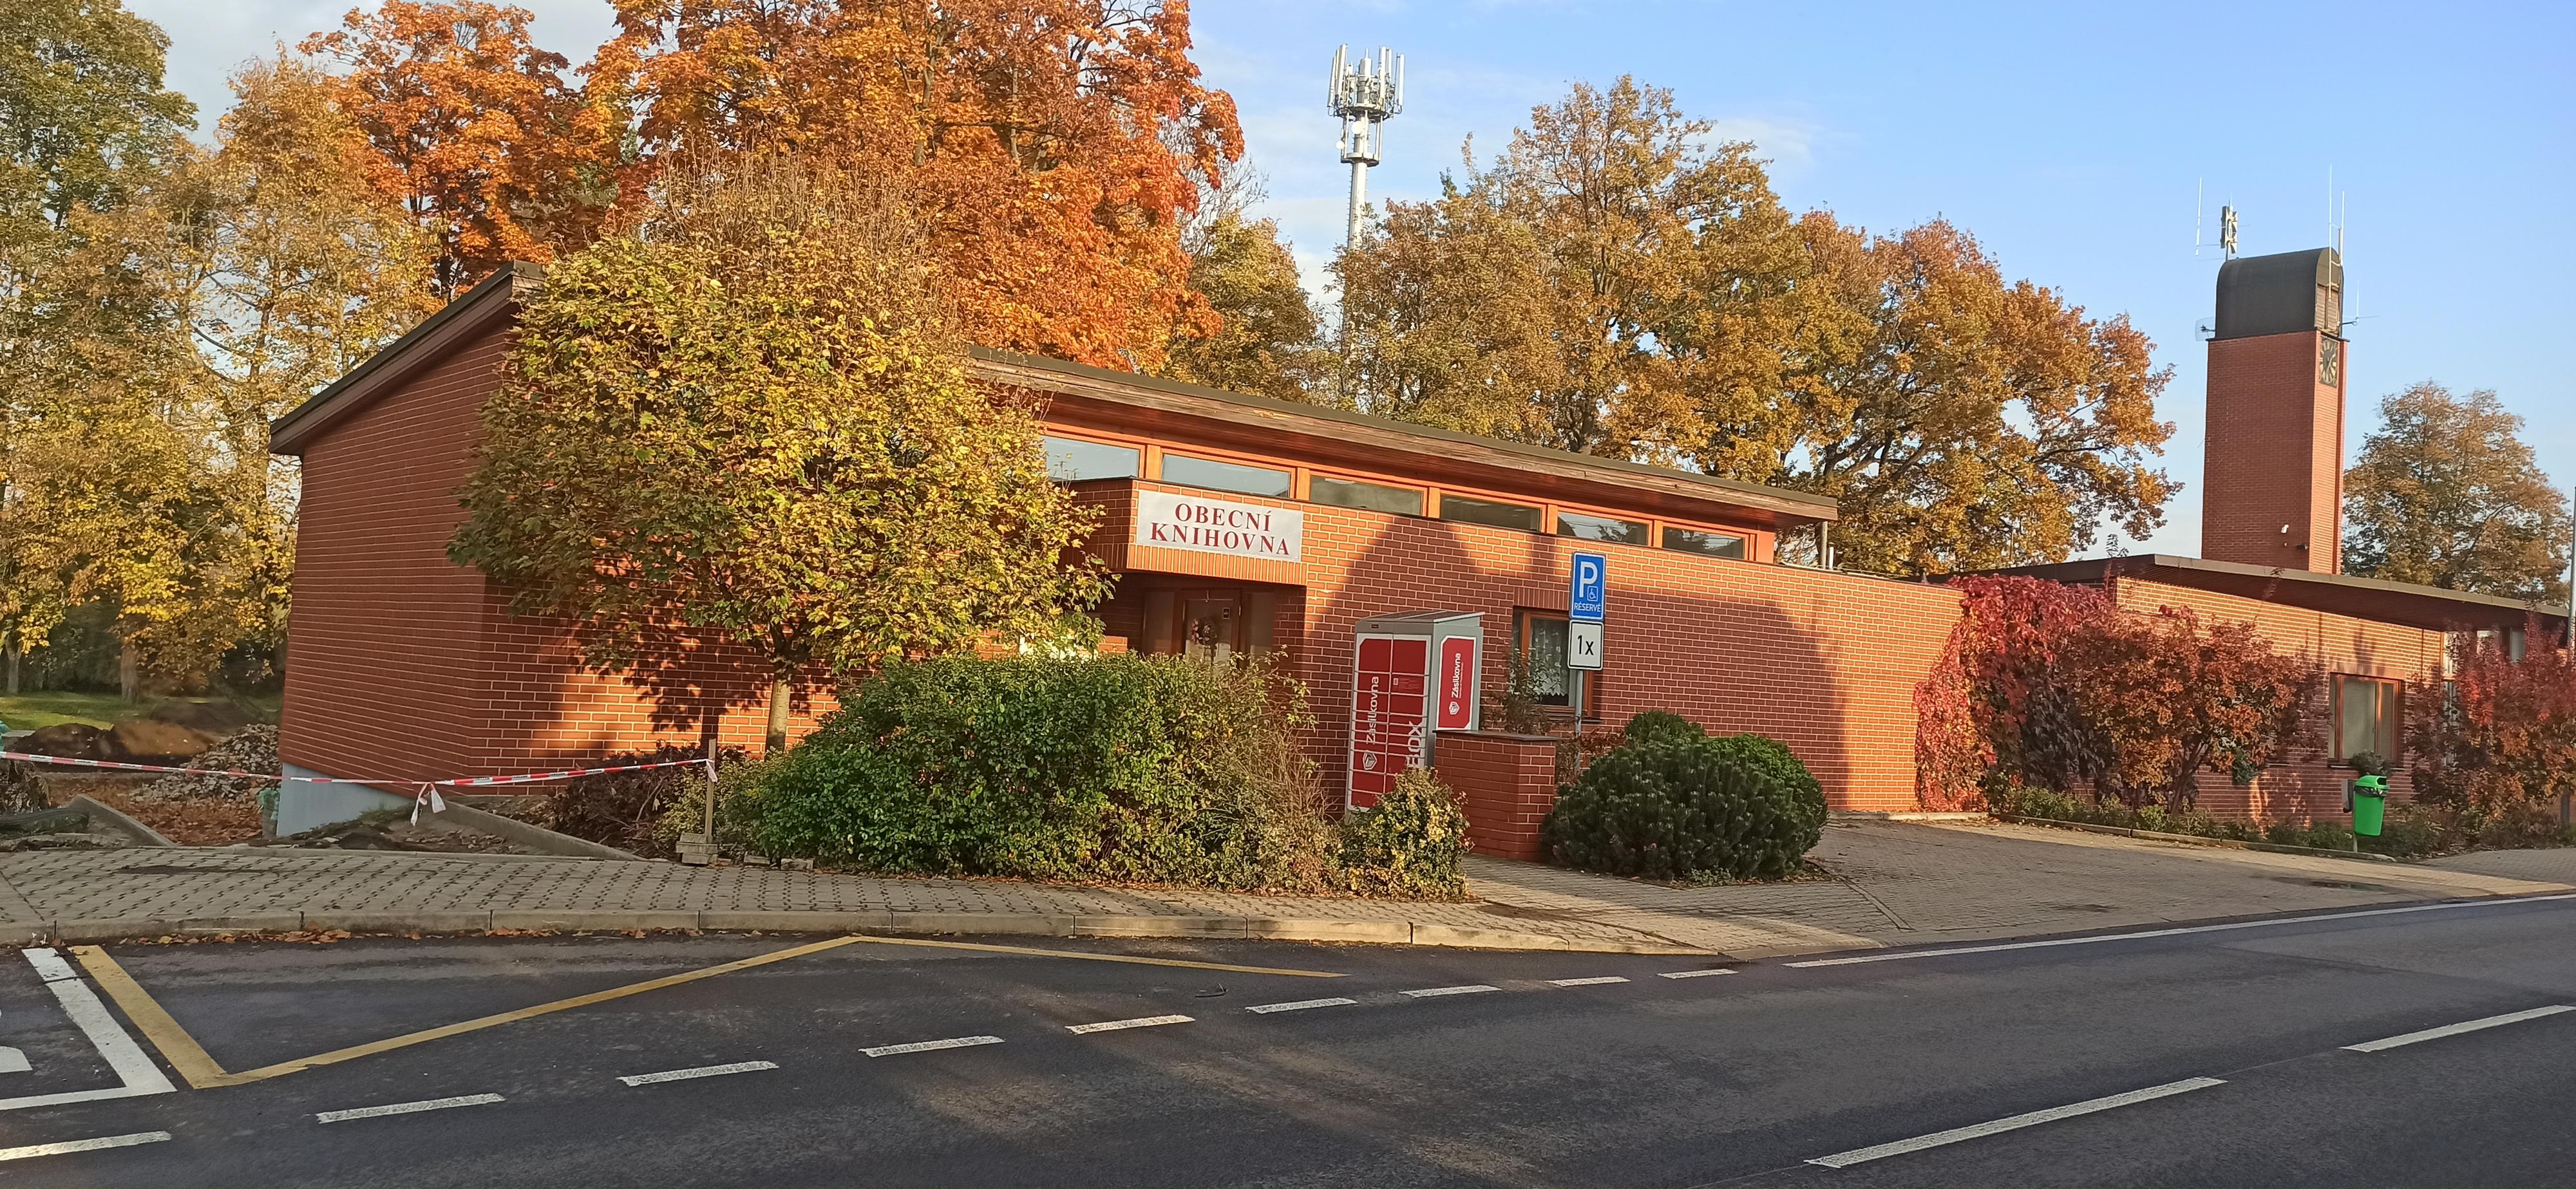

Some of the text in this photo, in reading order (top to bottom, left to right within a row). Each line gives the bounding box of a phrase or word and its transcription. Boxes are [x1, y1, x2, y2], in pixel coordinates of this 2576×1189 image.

[1175, 503, 1272, 531] OBECNÍ
[1150, 522, 1290, 556] KNIHOVNA
[1579, 561, 1598, 598] P
[1573, 601, 1601, 612] RÉSERVÉ
[1577, 635, 1594, 655] 1x
[1451, 653, 1461, 698] Zásilkovna
[1366, 676, 1379, 745] Zásilkovna
